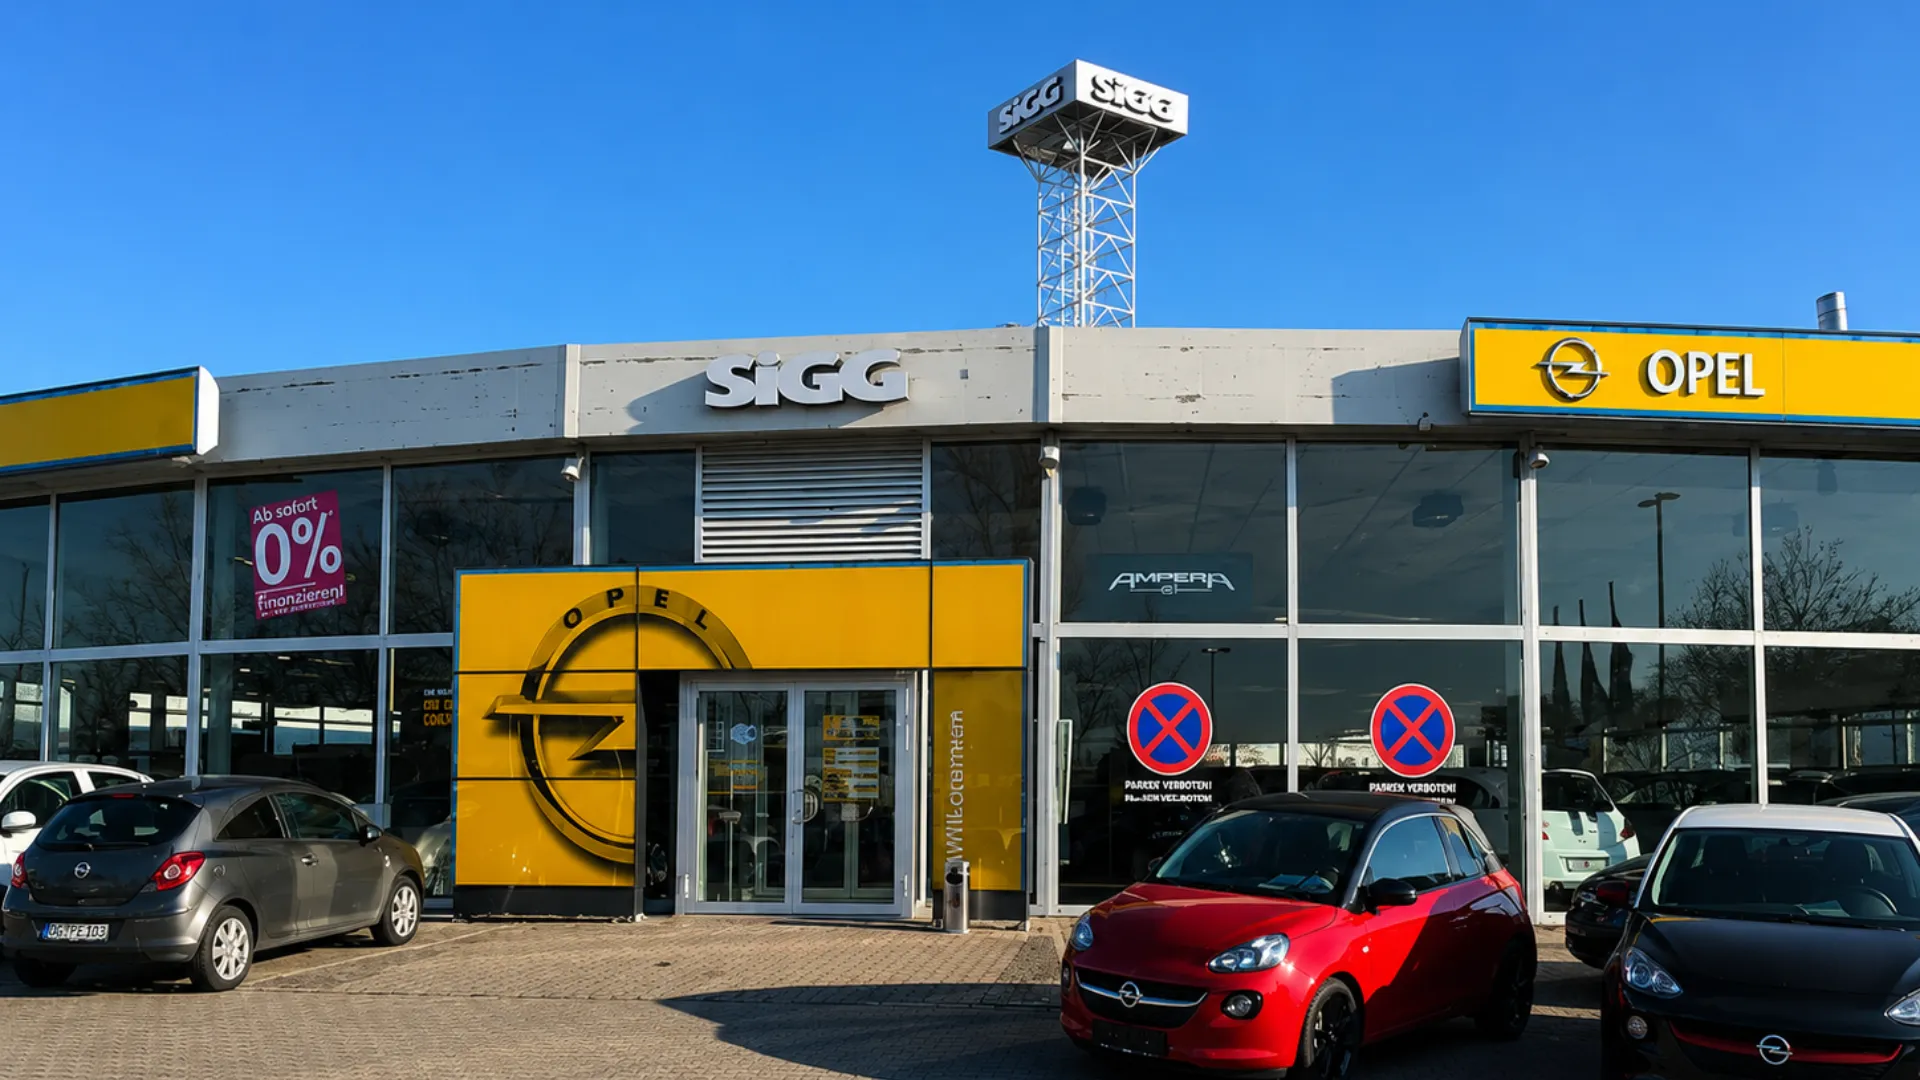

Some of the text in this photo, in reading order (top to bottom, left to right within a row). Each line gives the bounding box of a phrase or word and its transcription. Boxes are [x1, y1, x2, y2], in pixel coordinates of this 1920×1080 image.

[1647, 349, 1766, 396] OPEL
[253, 497, 318, 524] Ab sofort
[1108, 572, 1235, 591] AMPERA
[563, 588, 708, 630] OPEL
